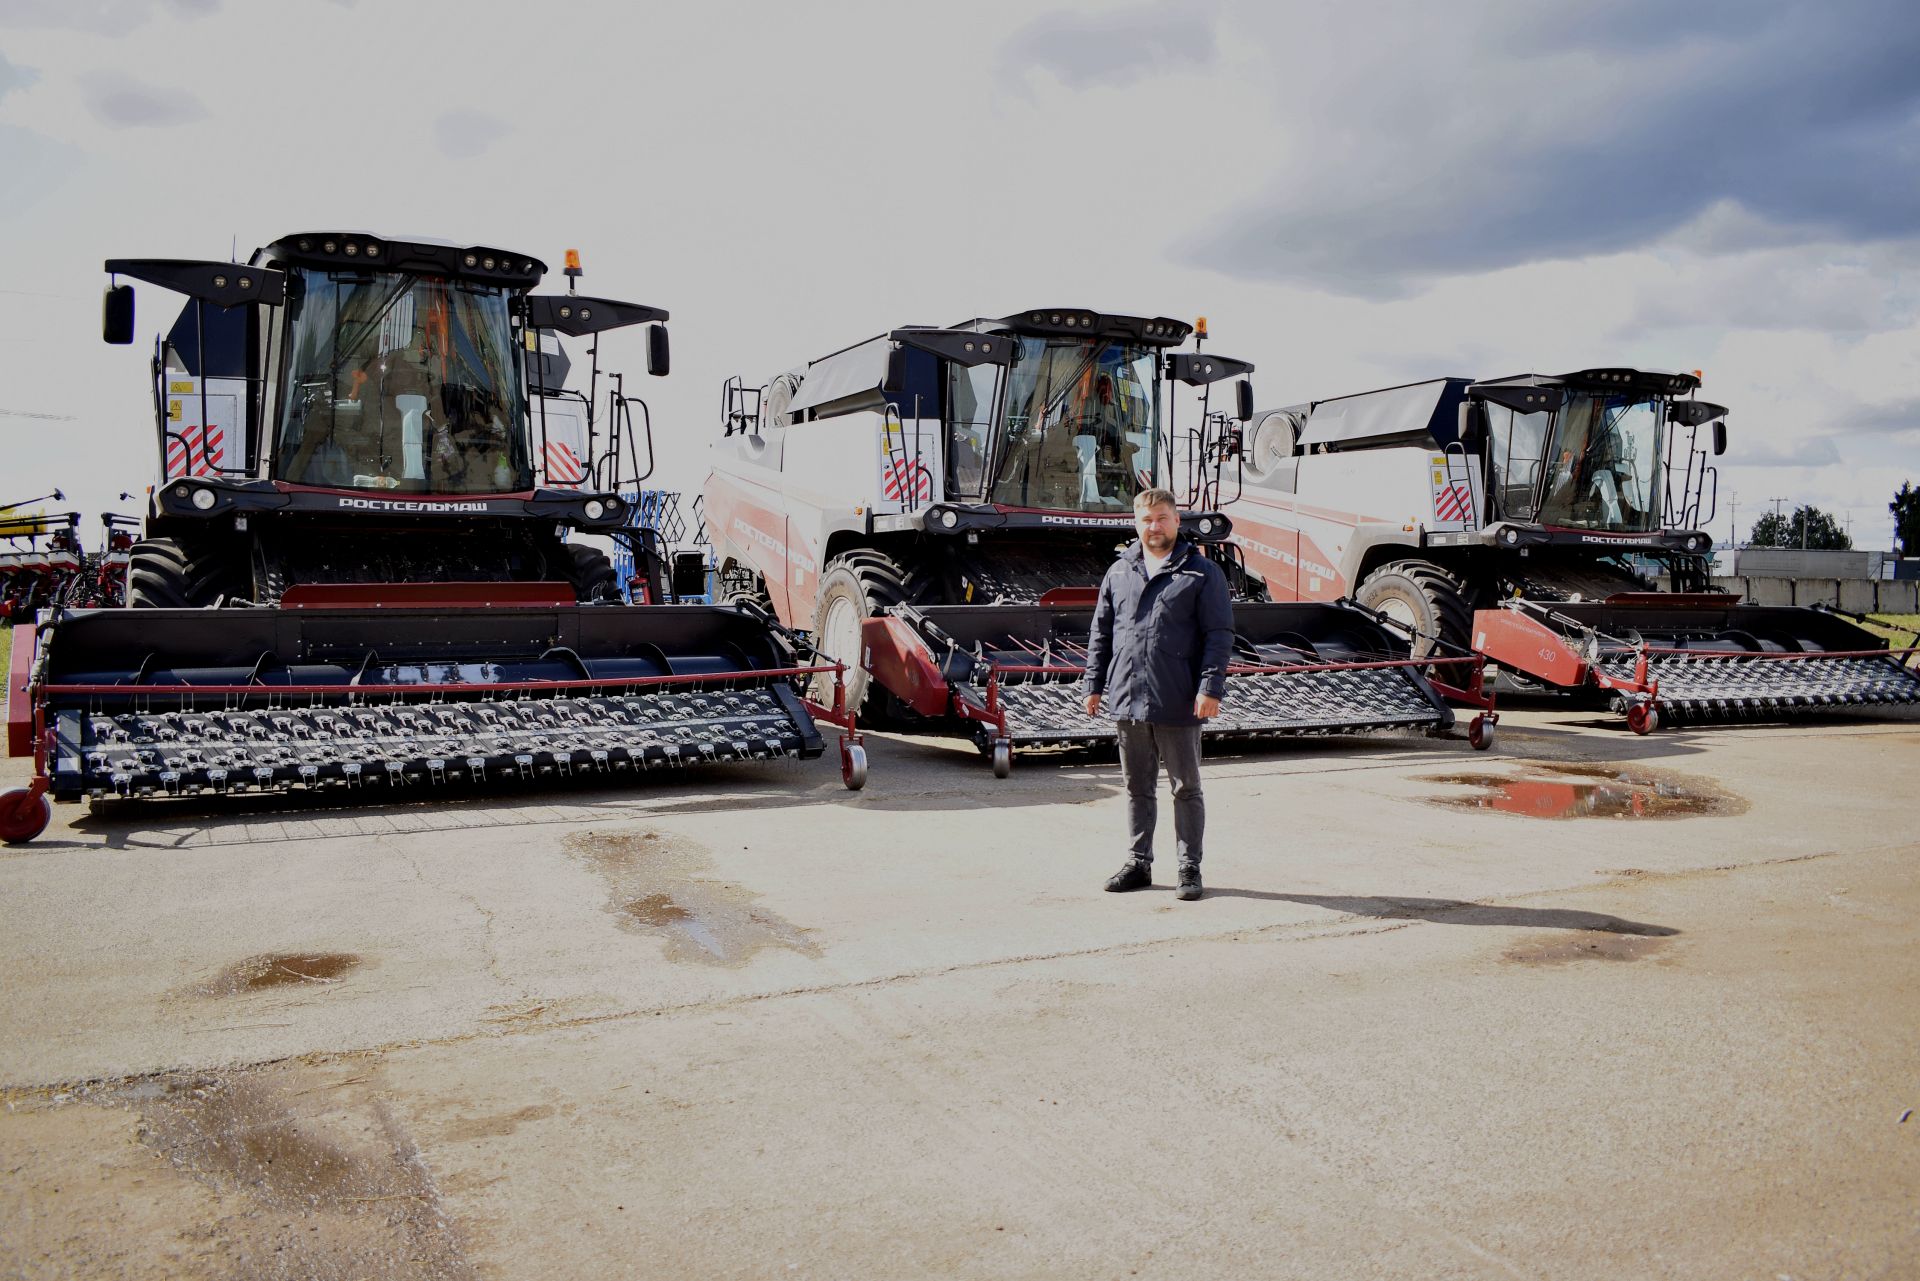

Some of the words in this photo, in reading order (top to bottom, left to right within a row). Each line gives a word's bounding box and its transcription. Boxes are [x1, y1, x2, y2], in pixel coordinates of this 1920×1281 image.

[339, 498, 488, 512] РОСТСЕЛЬМАШ
[1582, 535, 1652, 545] РОСТСЕЛЬМАШ
[1229, 532, 1336, 581] ОСТСЕЛЬМАШ
[1538, 648, 1556, 662] 430
